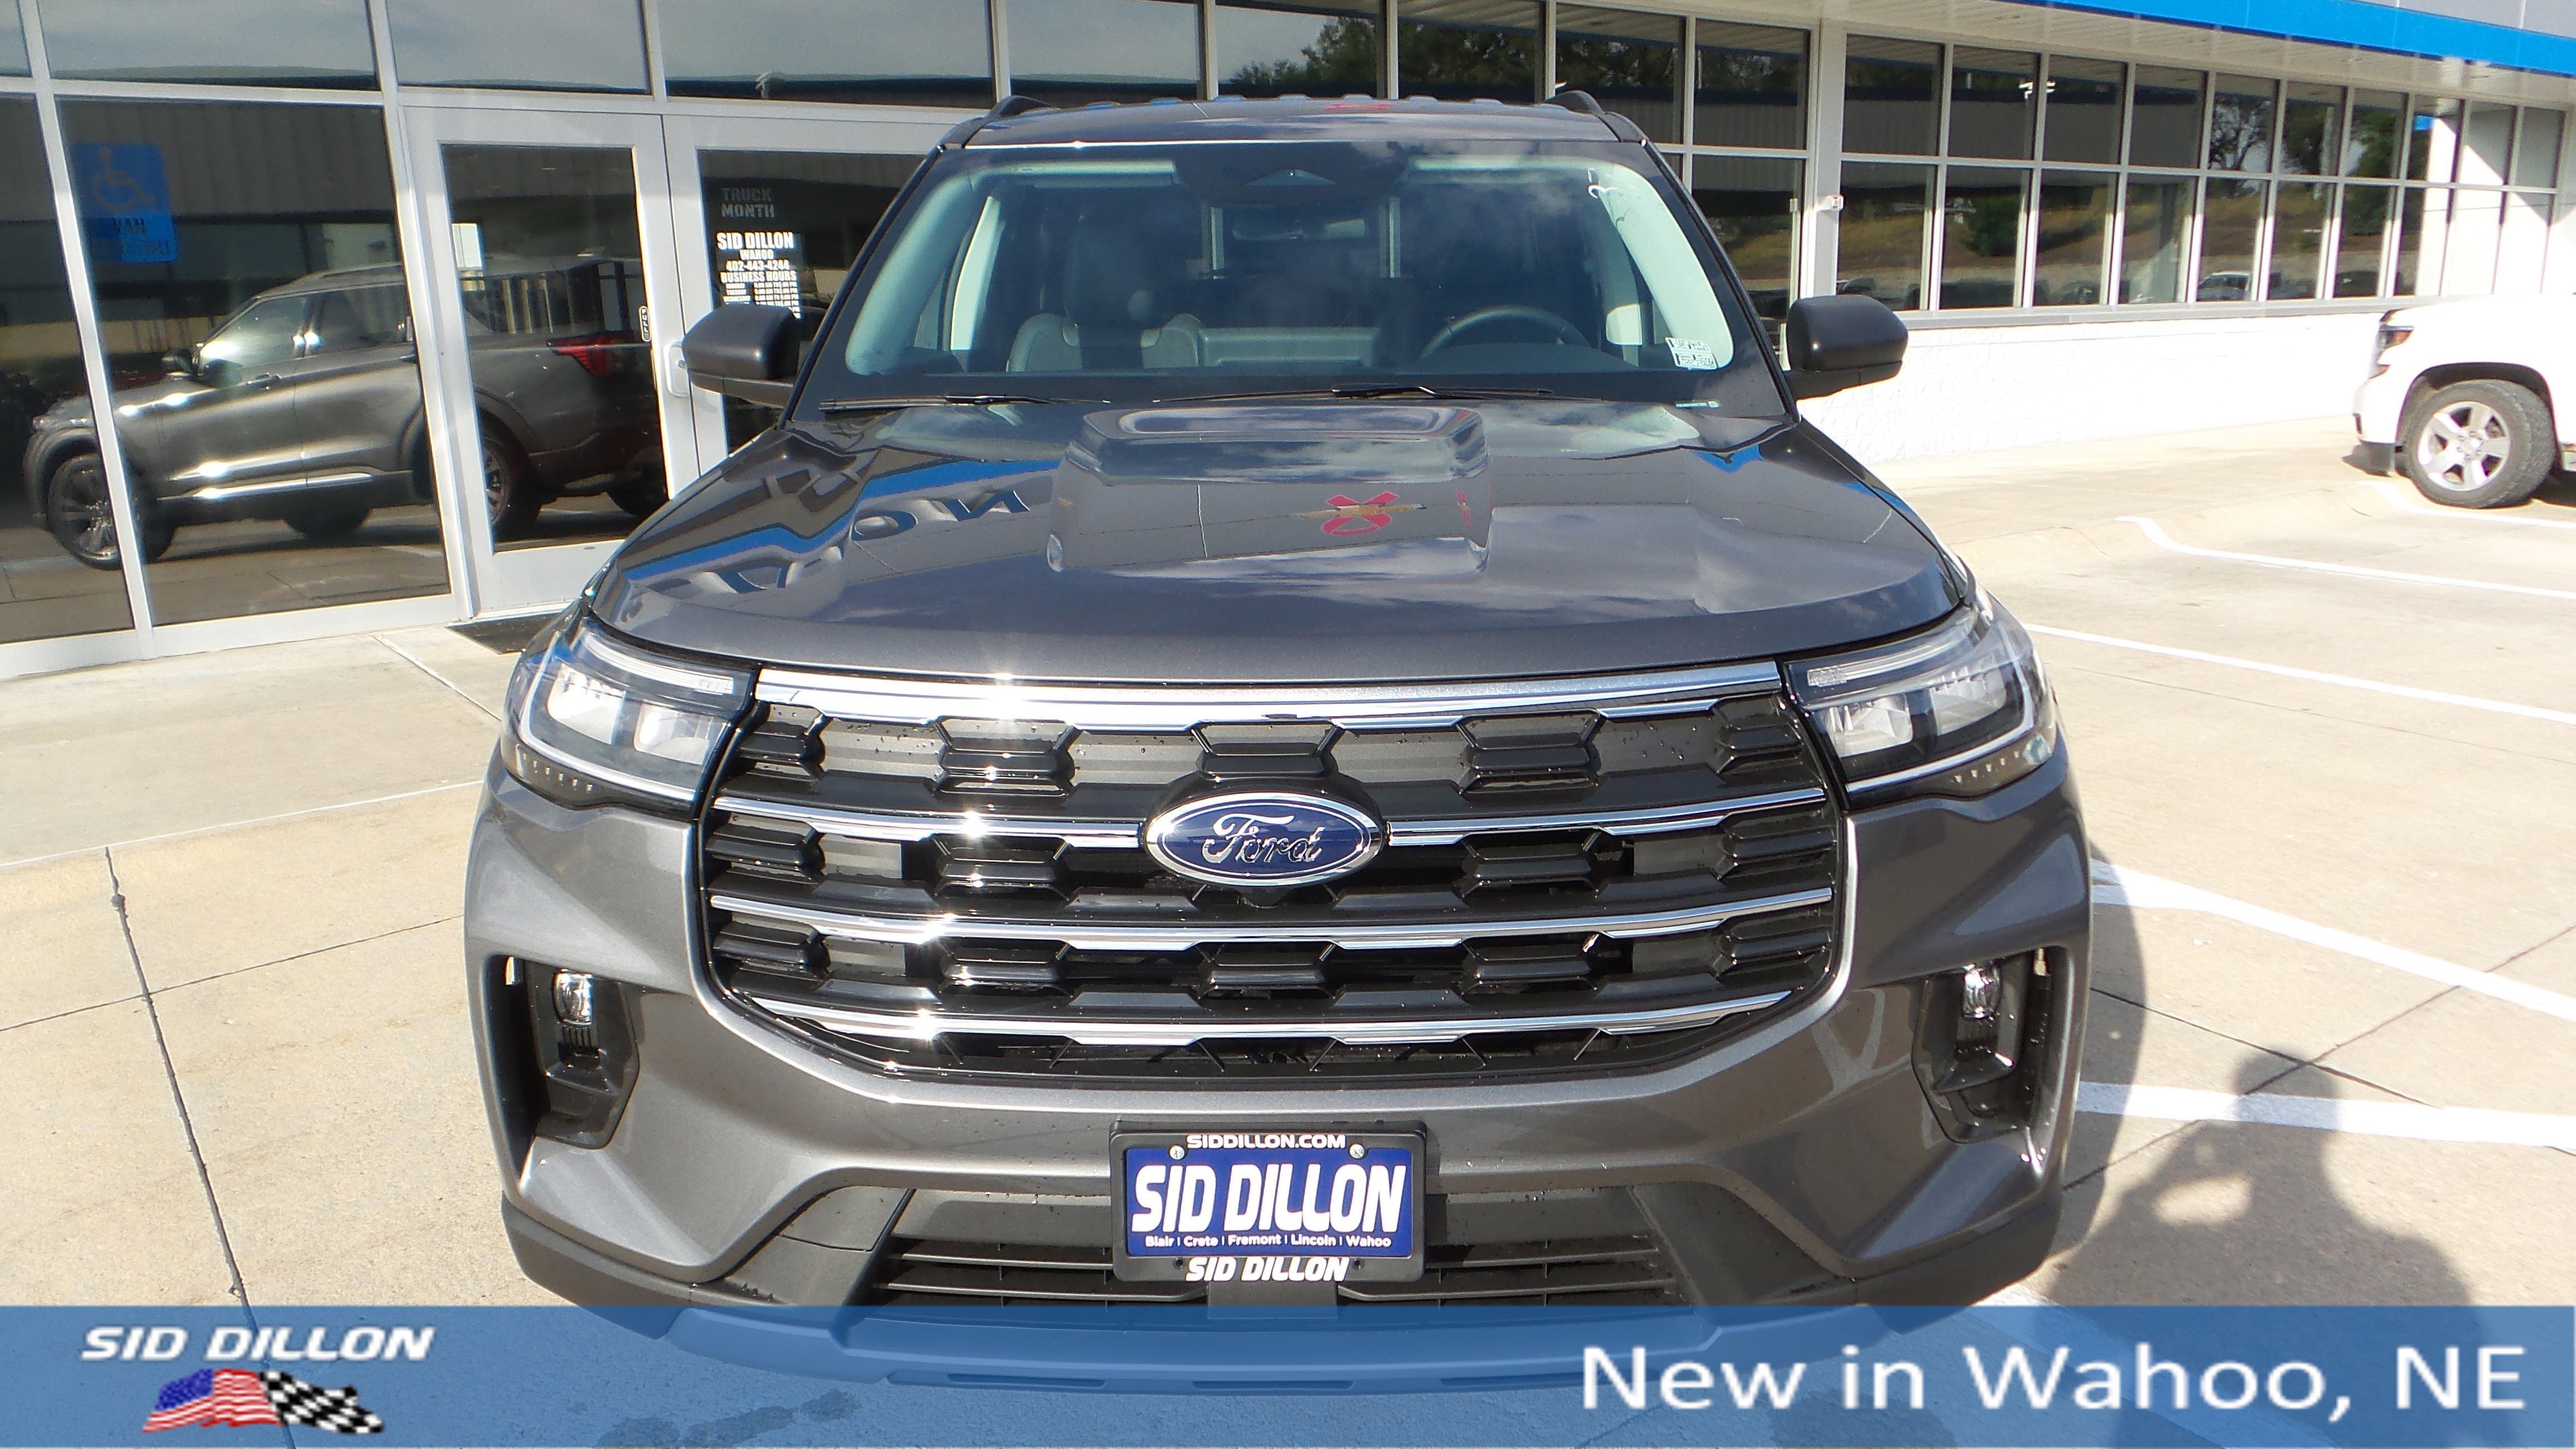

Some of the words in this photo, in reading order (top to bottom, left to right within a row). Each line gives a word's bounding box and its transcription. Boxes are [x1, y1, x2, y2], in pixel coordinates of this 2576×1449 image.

[721, 203, 776, 218] MONTH
[717, 232, 743, 250] SID
[744, 231, 794, 249] DILLON
[739, 249, 774, 261] WAHOO
[726, 259, 789, 272] 402-443-4244
[720, 272, 765, 283] BUSINESS
[765, 271, 797, 281] HOURS
[1201, 813, 1326, 864] Ford
[1186, 1134, 1346, 1149] SIDDILLON.COM
[1131, 1165, 1216, 1232] SID
[1223, 1163, 1407, 1233] DILLON
[1145, 1235, 1175, 1247] Blair
[1183, 1235, 1219, 1247] Crete
[1228, 1234, 1282, 1247] Fremont
[1291, 1234, 1337, 1247] Lincoln
[1345, 1235, 1391, 1247] Wahoo
[1185, 1257, 1237, 1282] SID
[1240, 1257, 1350, 1281] DILLON
